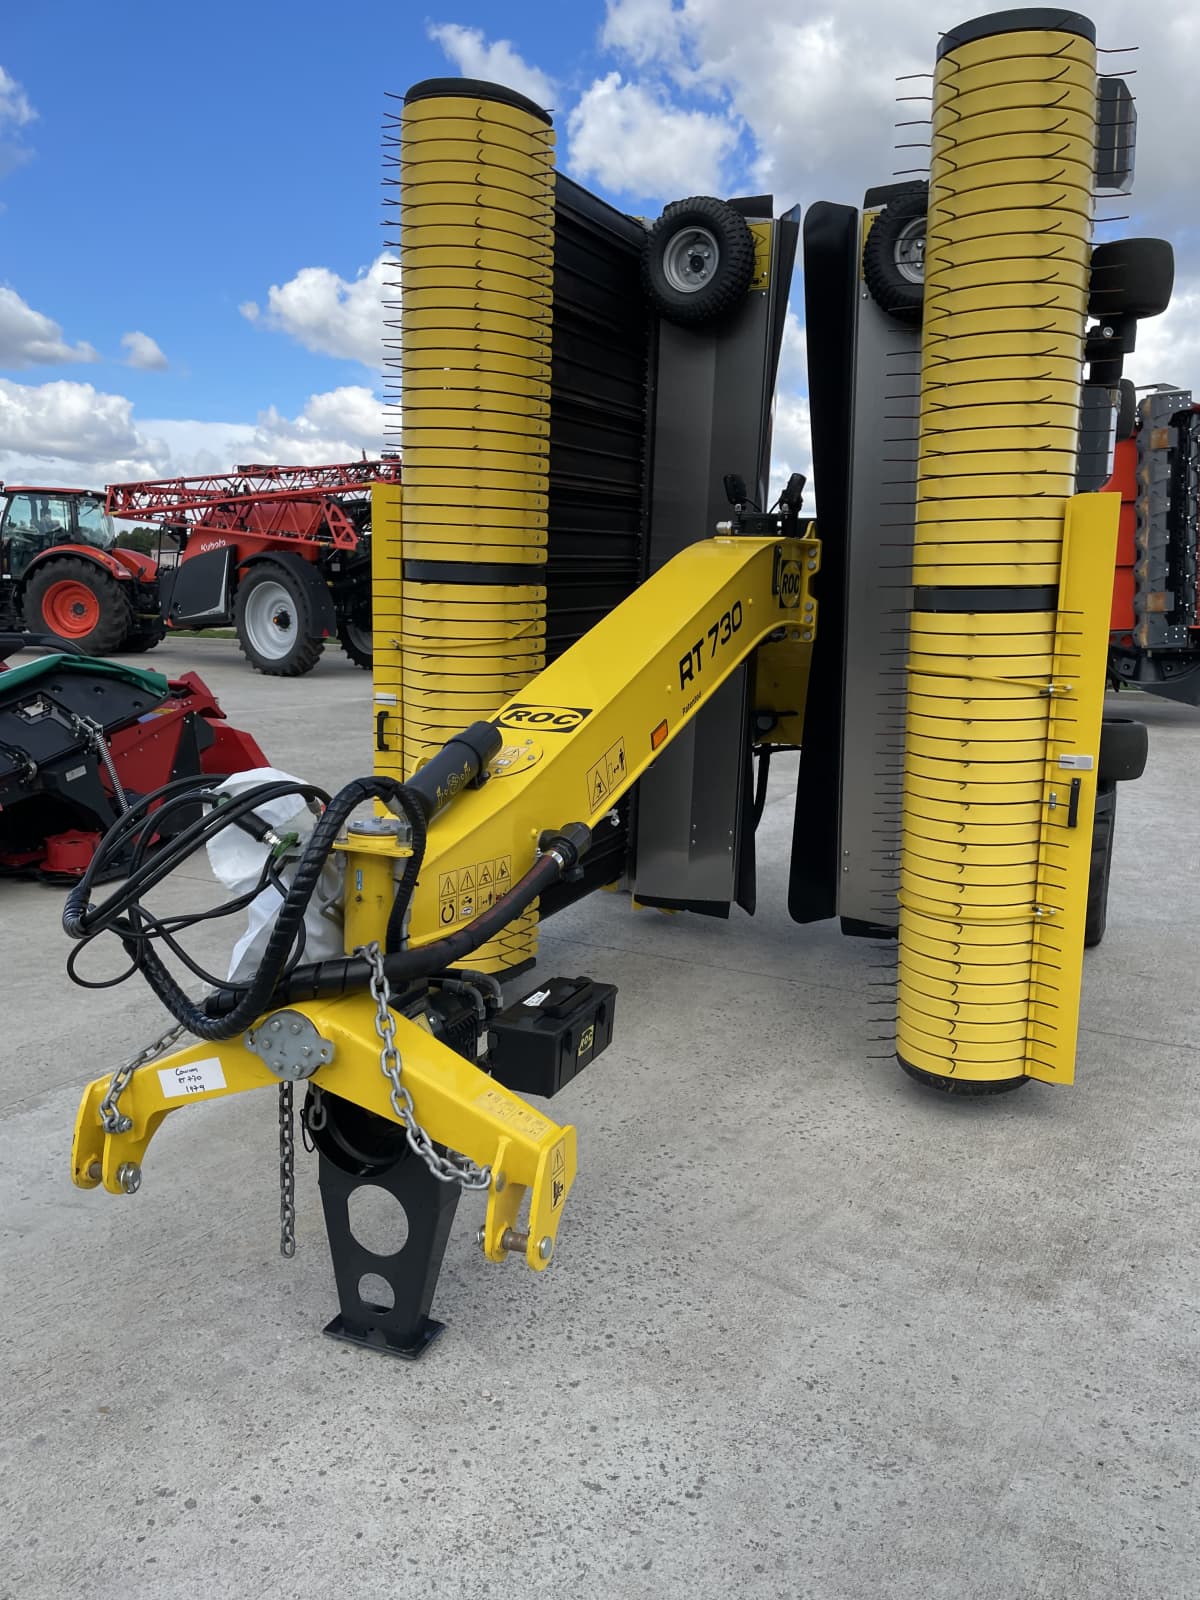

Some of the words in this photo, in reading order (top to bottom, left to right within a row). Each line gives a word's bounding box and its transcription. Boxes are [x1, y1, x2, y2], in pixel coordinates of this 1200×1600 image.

[200, 539, 226, 552] Kubota
[781, 573, 800, 594] ROC
[679, 637, 704, 691] RT
[707, 600, 743, 658] 730
[502, 710, 579, 725] ROC
